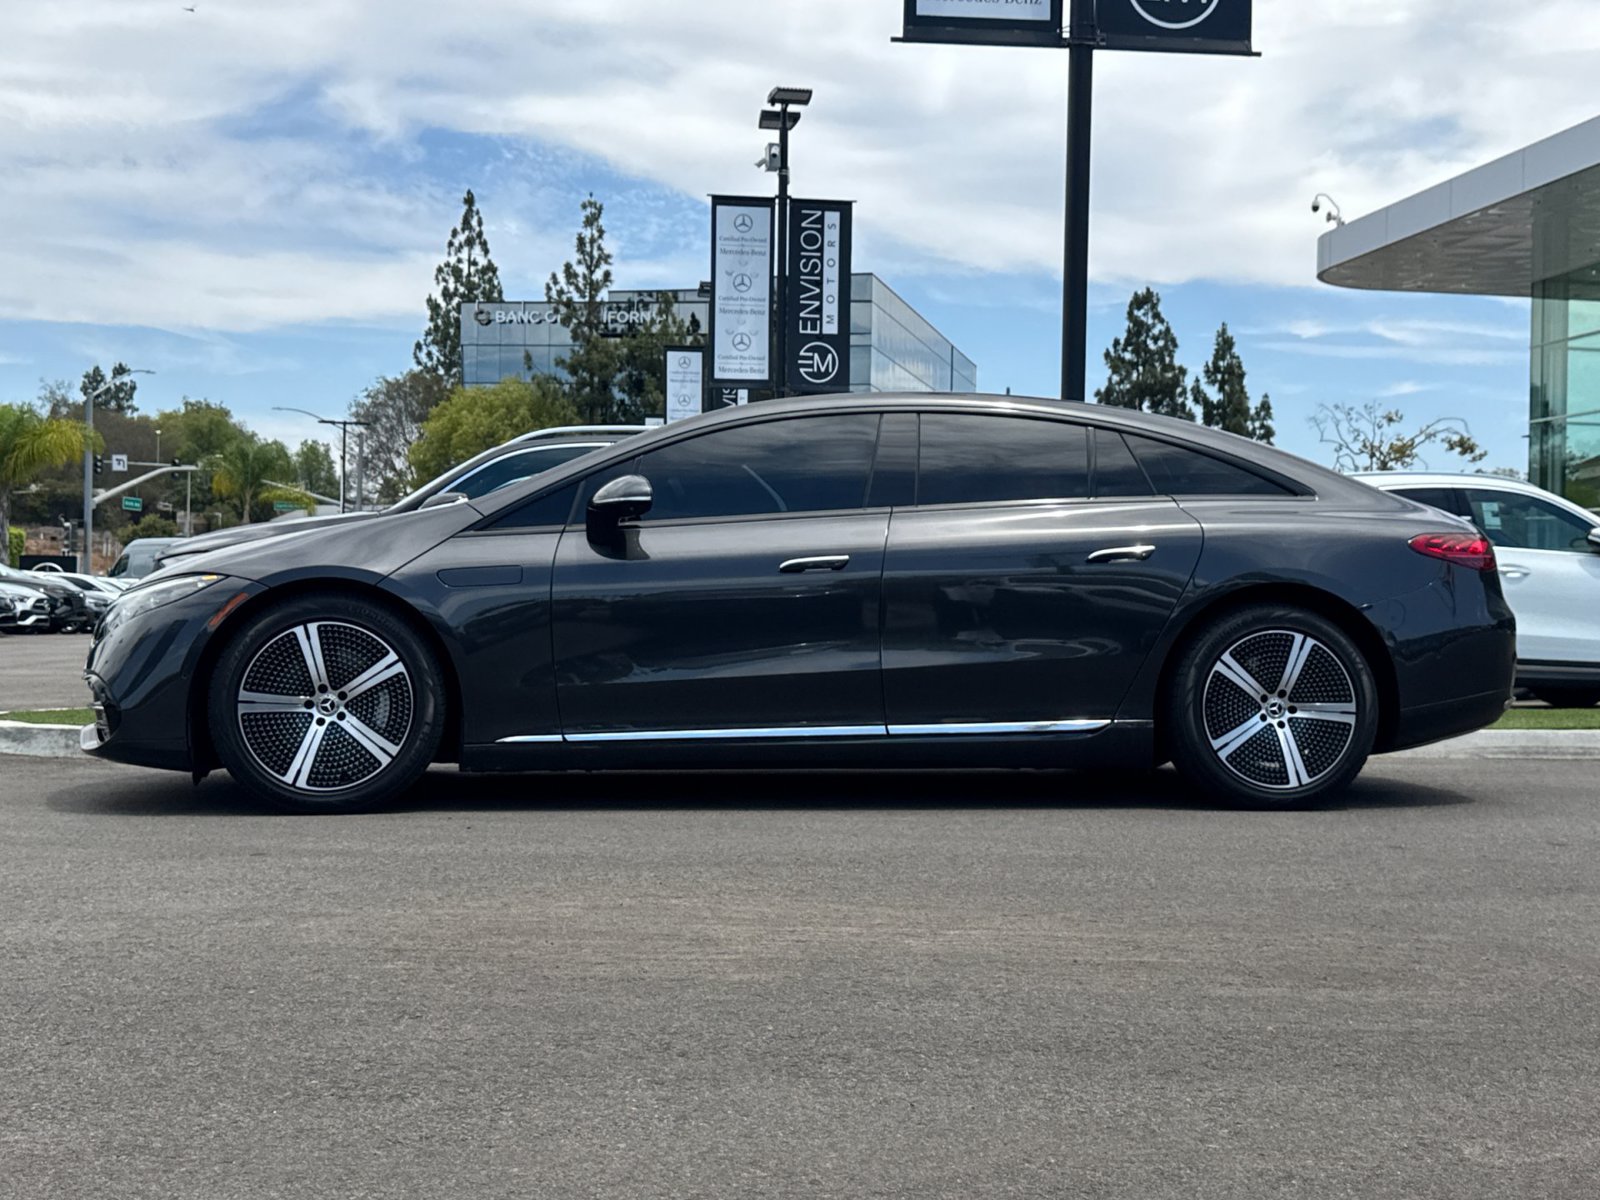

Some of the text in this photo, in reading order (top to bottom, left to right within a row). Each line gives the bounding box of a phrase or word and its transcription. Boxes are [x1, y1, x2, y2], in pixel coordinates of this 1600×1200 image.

[496, 310, 541, 324] BANC
[545, 310, 561, 323] O
[799, 209, 822, 334] ENVISION
[825, 223, 837, 325] MOTORS
